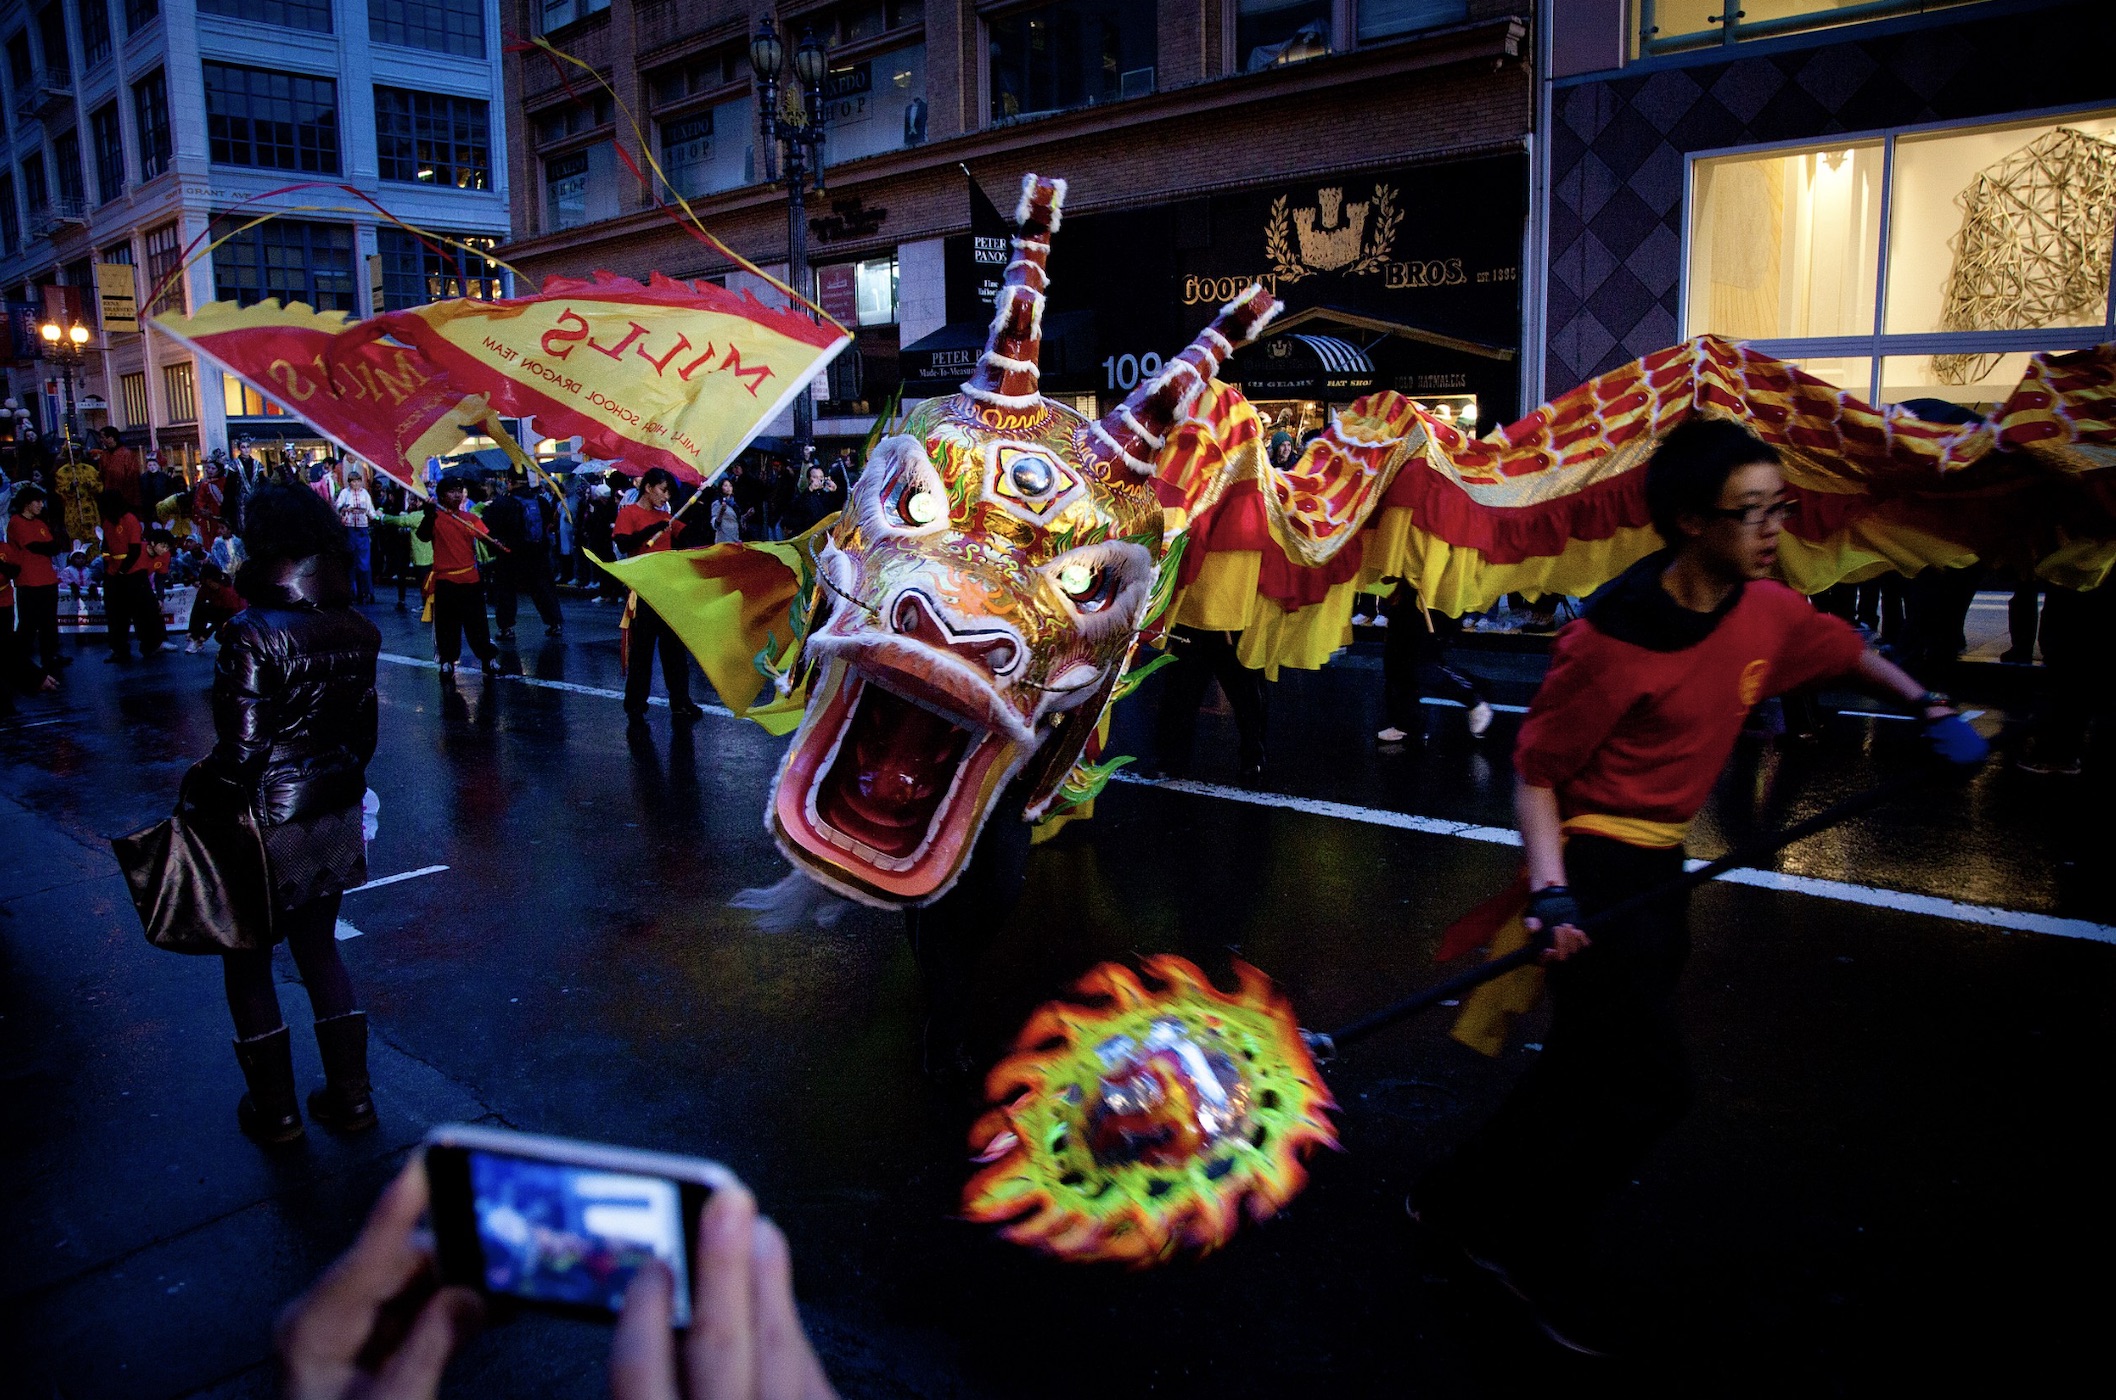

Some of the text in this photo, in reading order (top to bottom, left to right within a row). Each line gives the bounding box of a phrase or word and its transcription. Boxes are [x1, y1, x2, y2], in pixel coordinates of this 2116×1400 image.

[667, 140, 710, 165] SHOP
[186, 187, 225, 197] GRANT
[550, 177, 585, 196] SHOP
[974, 236, 1007, 249] PETER
[974, 250, 1008, 262] PANOS
[1385, 258, 1468, 288] BROS.
[1492, 267, 1517, 281] 1895
[932, 349, 970, 364] PETER
[919, 366, 976, 378] Made-To-Measur
[1102, 351, 1163, 390] 109
